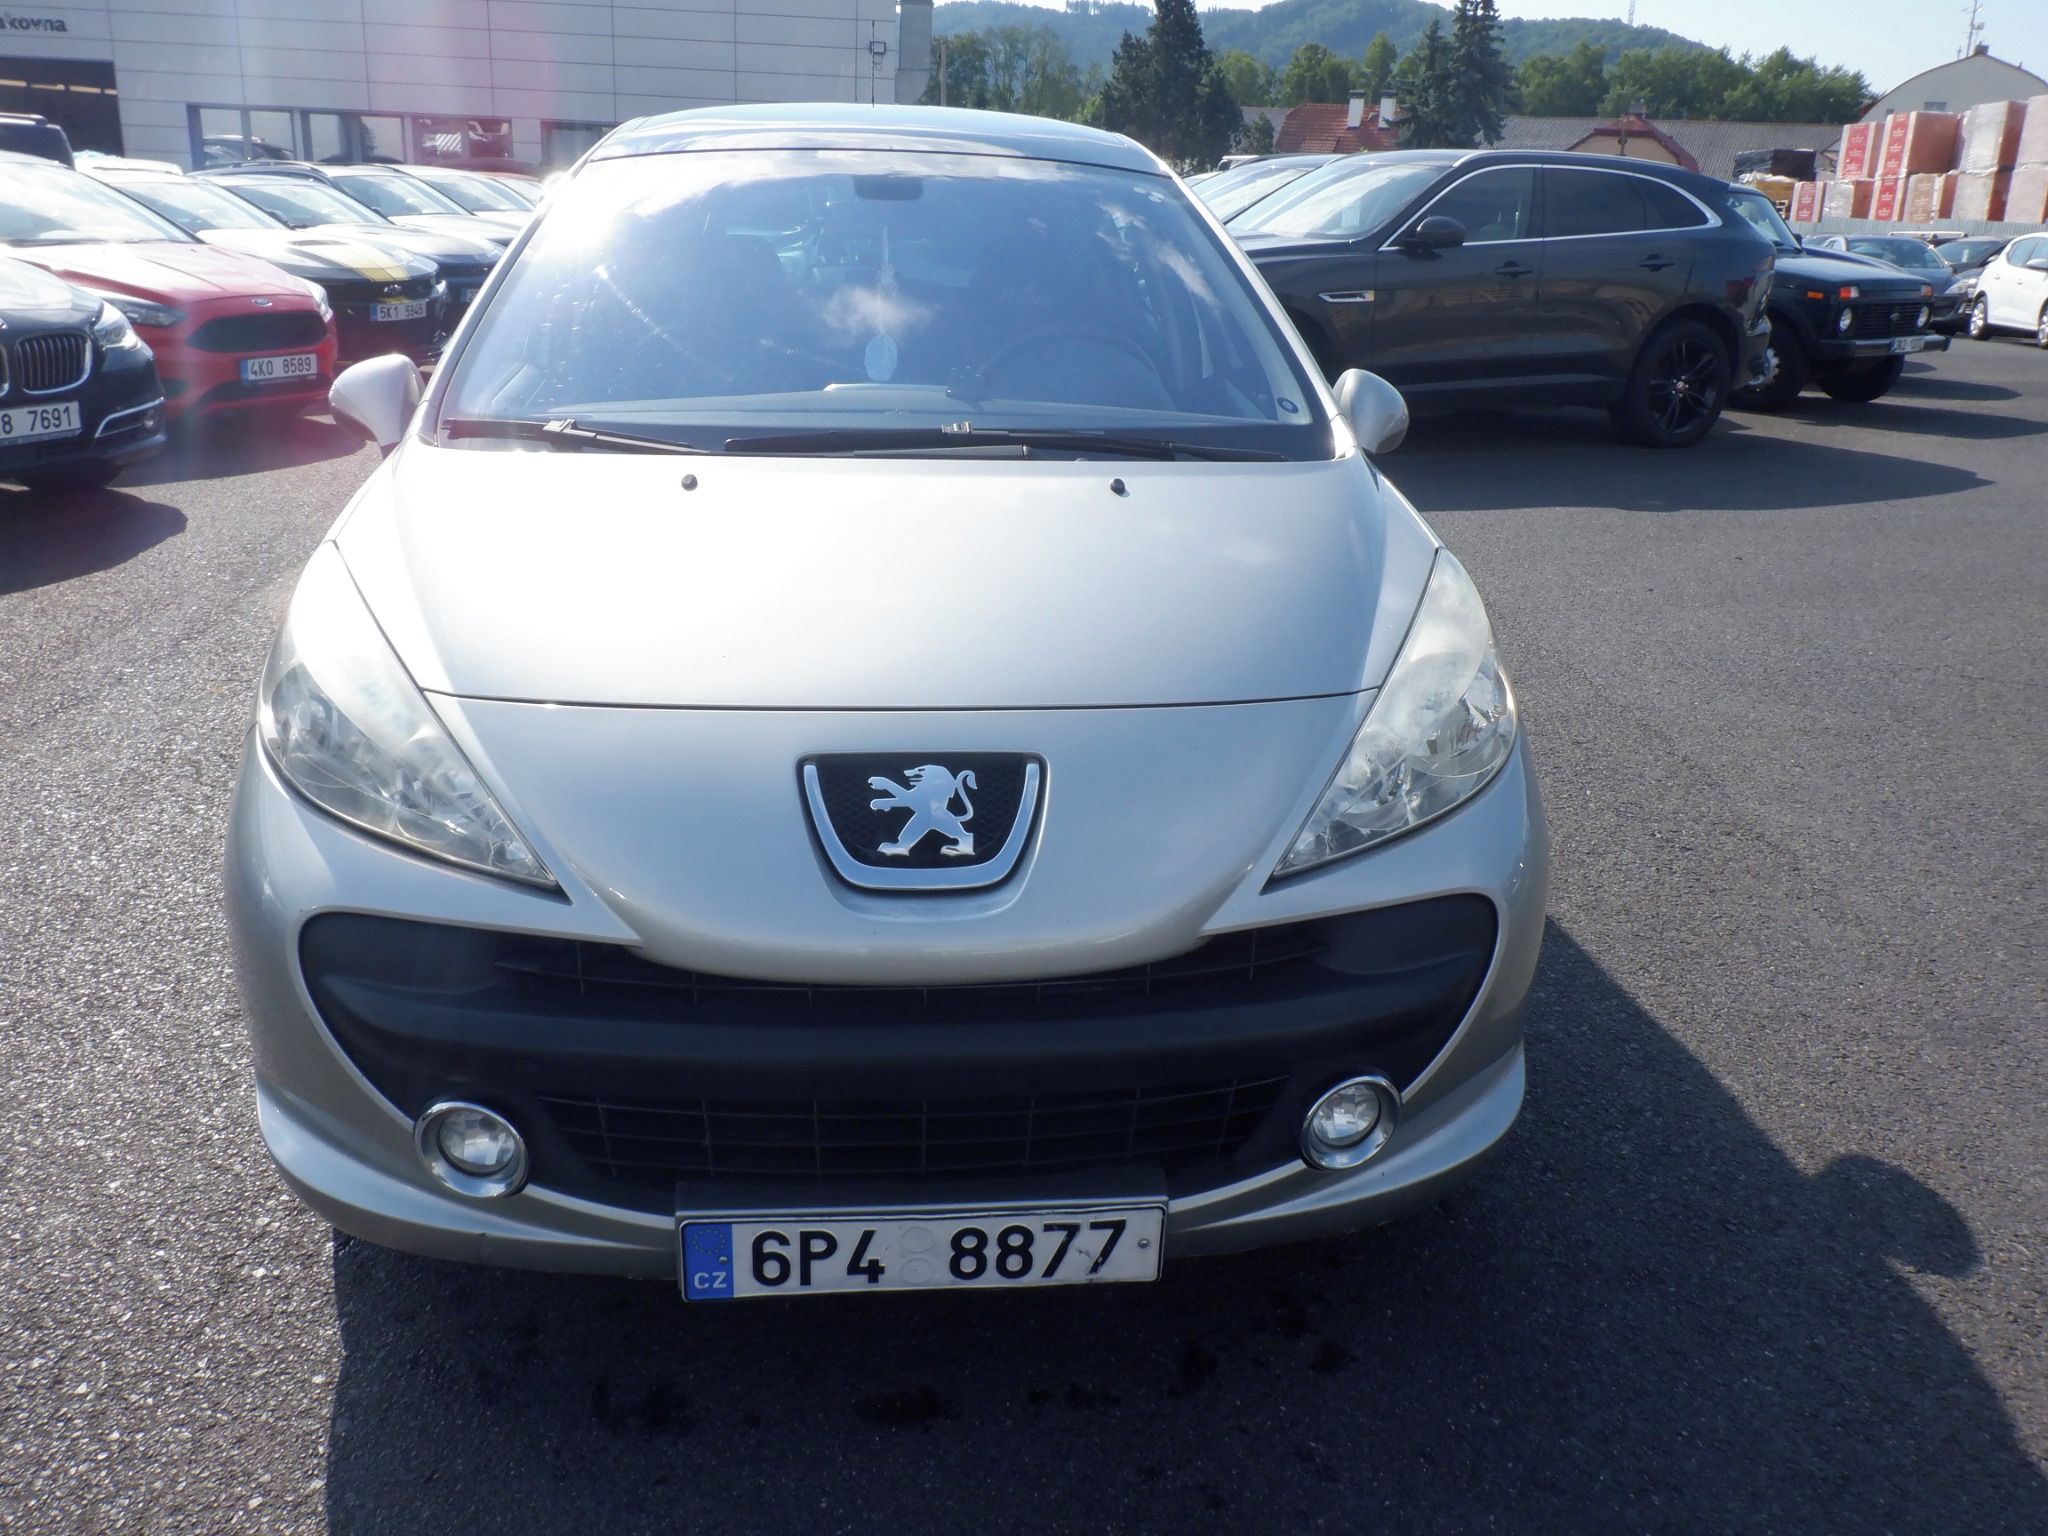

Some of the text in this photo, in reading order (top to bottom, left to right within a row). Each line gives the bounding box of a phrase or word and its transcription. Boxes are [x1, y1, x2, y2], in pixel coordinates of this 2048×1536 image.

[379, 305, 399, 320] 5K1
[282, 356, 312, 375] 8589
[27, 406, 72, 432] 7691
[751, 1218, 1127, 1286] 6P4 8877
[694, 1271, 727, 1289] CZ
